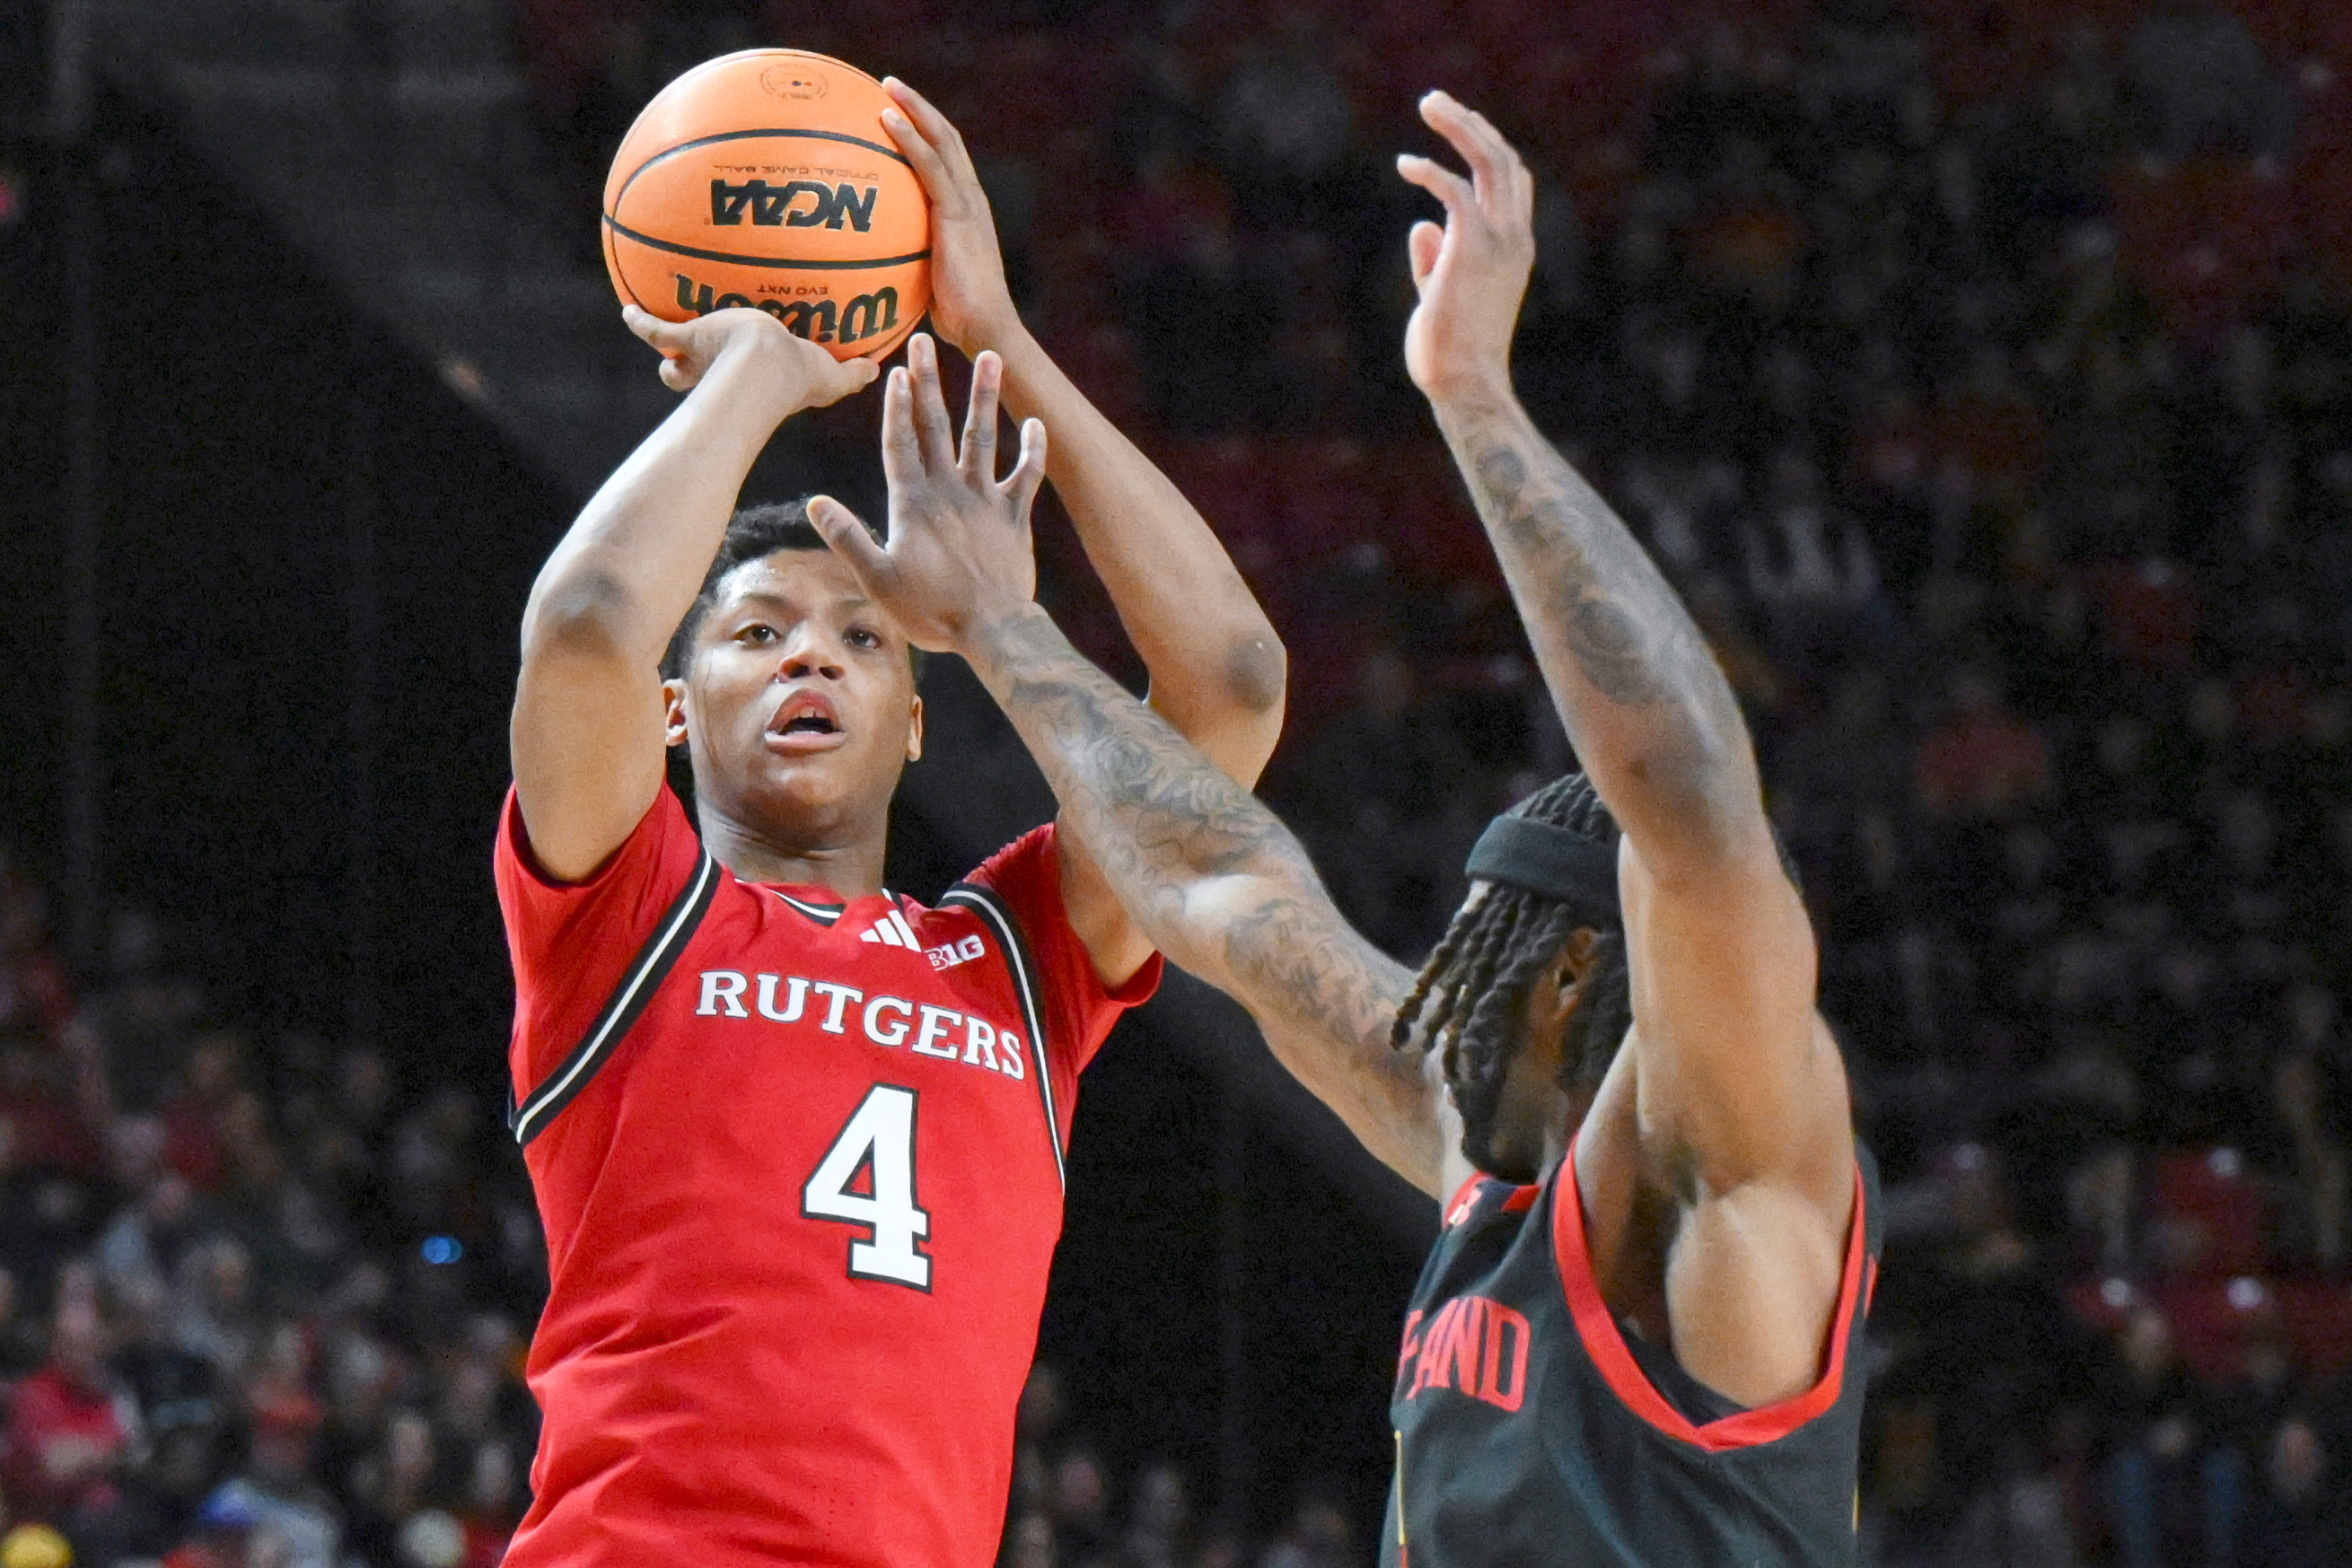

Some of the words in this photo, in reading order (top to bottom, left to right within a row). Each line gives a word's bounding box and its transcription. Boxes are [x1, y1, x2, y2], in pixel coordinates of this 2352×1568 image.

[761, 166, 809, 174] GAME
[711, 179, 878, 232] NCAA
[757, 285, 792, 294] NXT
[795, 286, 828, 295] EVO
[695, 970, 1025, 1081] RUTGERS
[802, 1082, 933, 1295] 4
